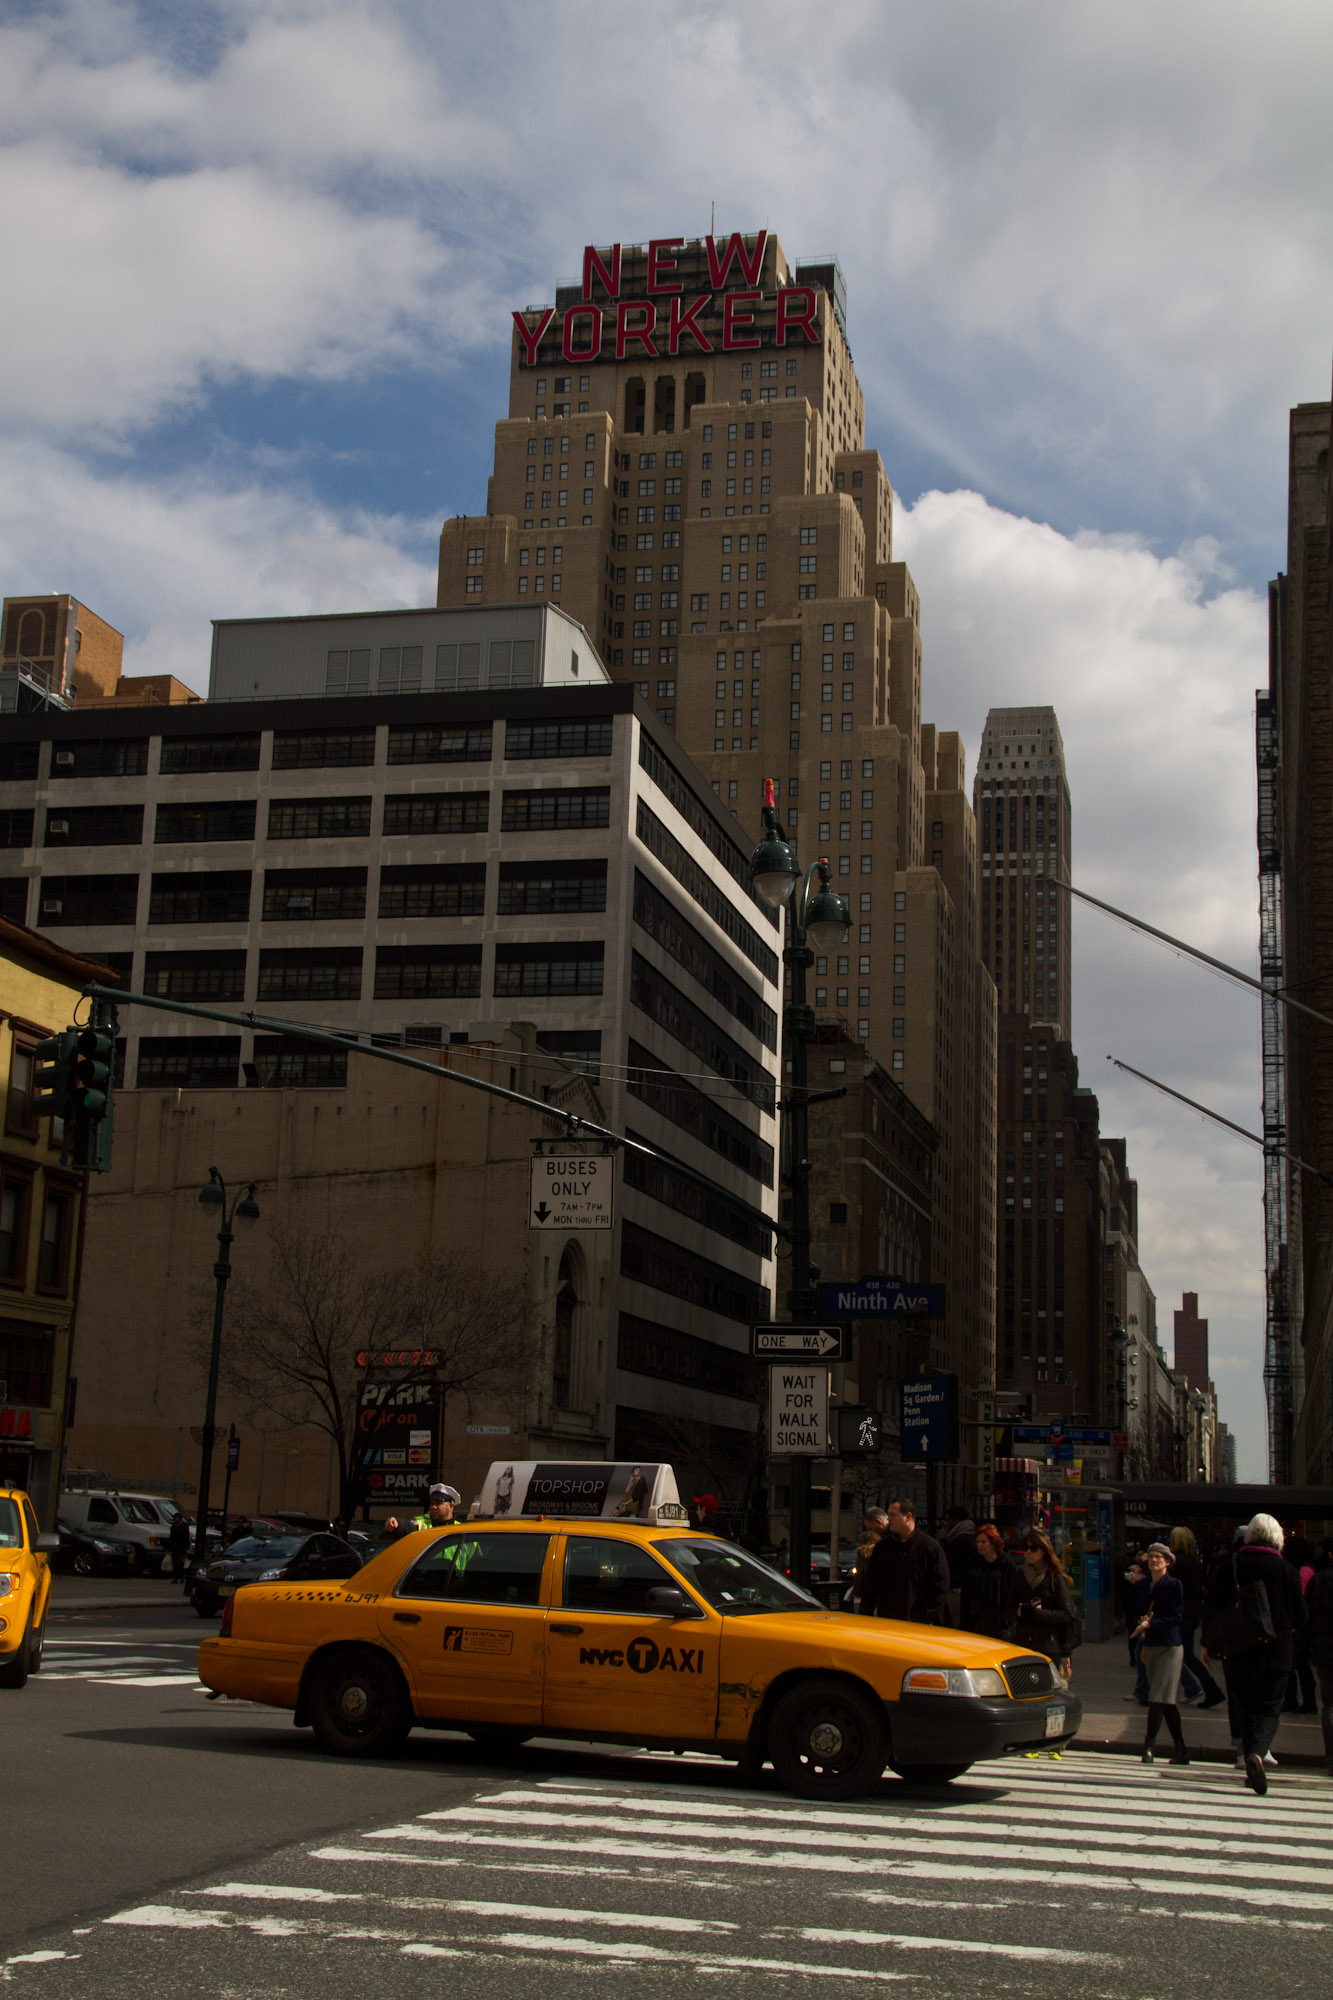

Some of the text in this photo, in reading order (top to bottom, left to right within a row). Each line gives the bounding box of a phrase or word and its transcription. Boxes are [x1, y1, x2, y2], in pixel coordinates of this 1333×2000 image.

[582, 229, 768, 300] NEW
[511, 286, 821, 367] YORKER
[546, 1161, 597, 1175] BUSES
[551, 1182, 592, 1196] ONLY
[553, 1215, 609, 1225] MON THRU FRI
[886, 1281, 901, 1289] 420
[837, 1291, 888, 1310] Ninth
[761, 1336, 828, 1348] ONE WAY
[782, 1375, 816, 1389] WAIT
[904, 1383, 932, 1393] Madison
[361, 1383, 433, 1406] PARK
[785, 1394, 813, 1408] FOR
[904, 1396, 913, 1406] Sq
[971, 1391, 994, 1399] HOTEL
[904, 1407, 921, 1415] Penn
[779, 1413, 819, 1427] WALK
[904, 1417, 930, 1427] Station
[776, 1431, 821, 1446] SIGNAL
[385, 1474, 431, 1488] PARK
[531, 1479, 605, 1494] TOPSHOP
[664, 1504, 678, 1518] 6J91
[580, 1636, 704, 1674] NYC TAXI
